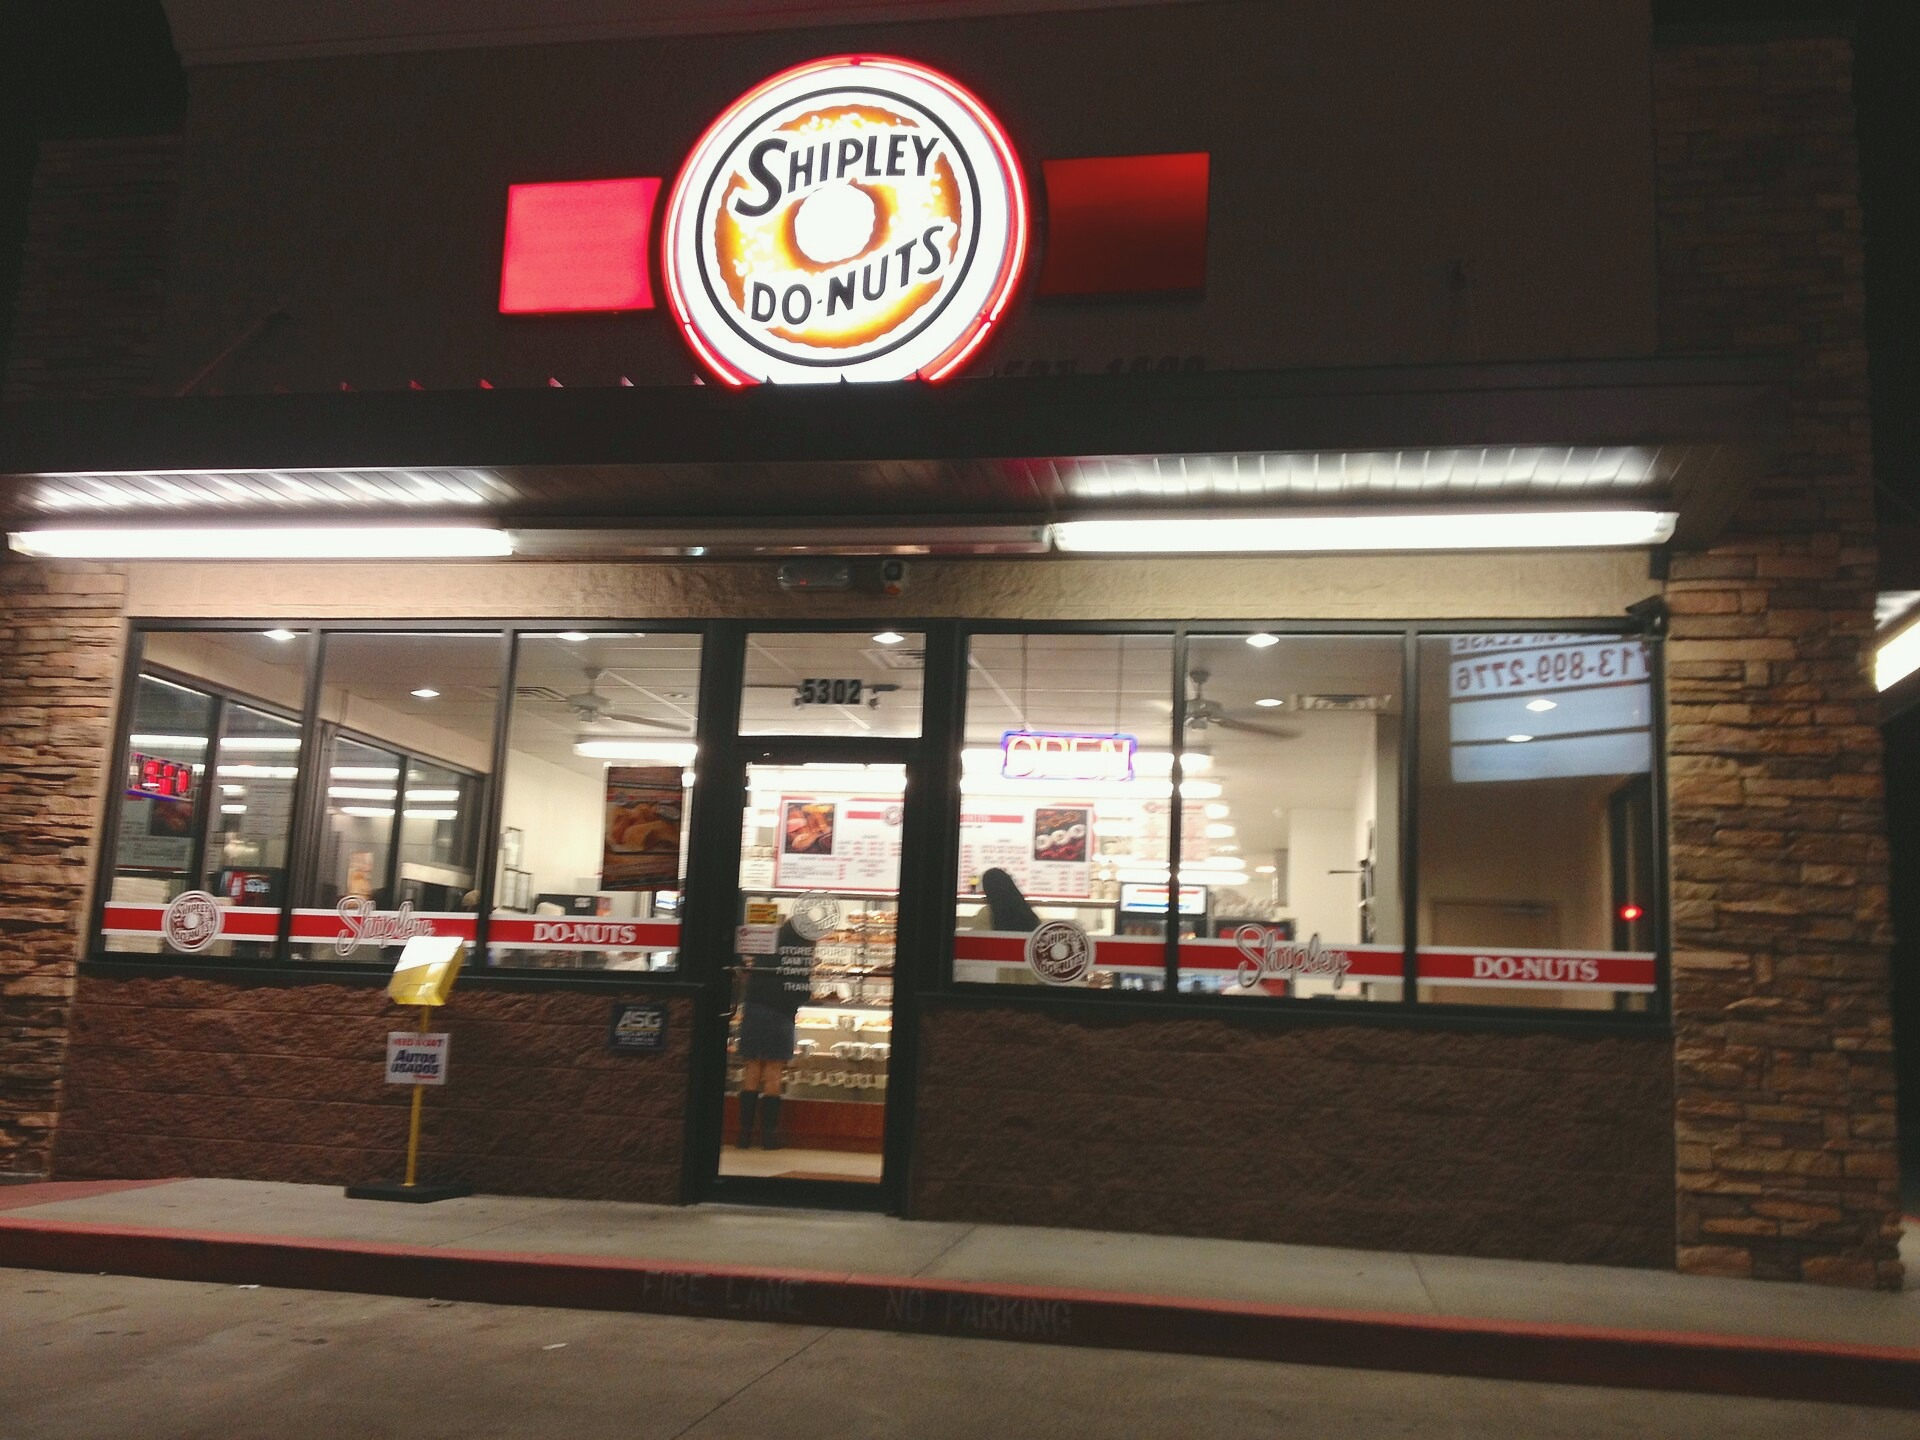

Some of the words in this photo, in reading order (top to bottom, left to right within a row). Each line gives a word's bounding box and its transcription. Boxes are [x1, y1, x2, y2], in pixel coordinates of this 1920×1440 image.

[734, 134, 940, 218] SHIPLEY
[802, 679, 862, 704] 5302
[533, 922, 637, 943] DO-NUTS
[1473, 956, 1599, 981] DO-NUTS
[614, 1010, 662, 1029] ASG
[642, 1270, 704, 1308] FIRE
[725, 1276, 802, 1316] LANE
[884, 1286, 925, 1322] NO
[943, 1292, 1073, 1336] PARKING
